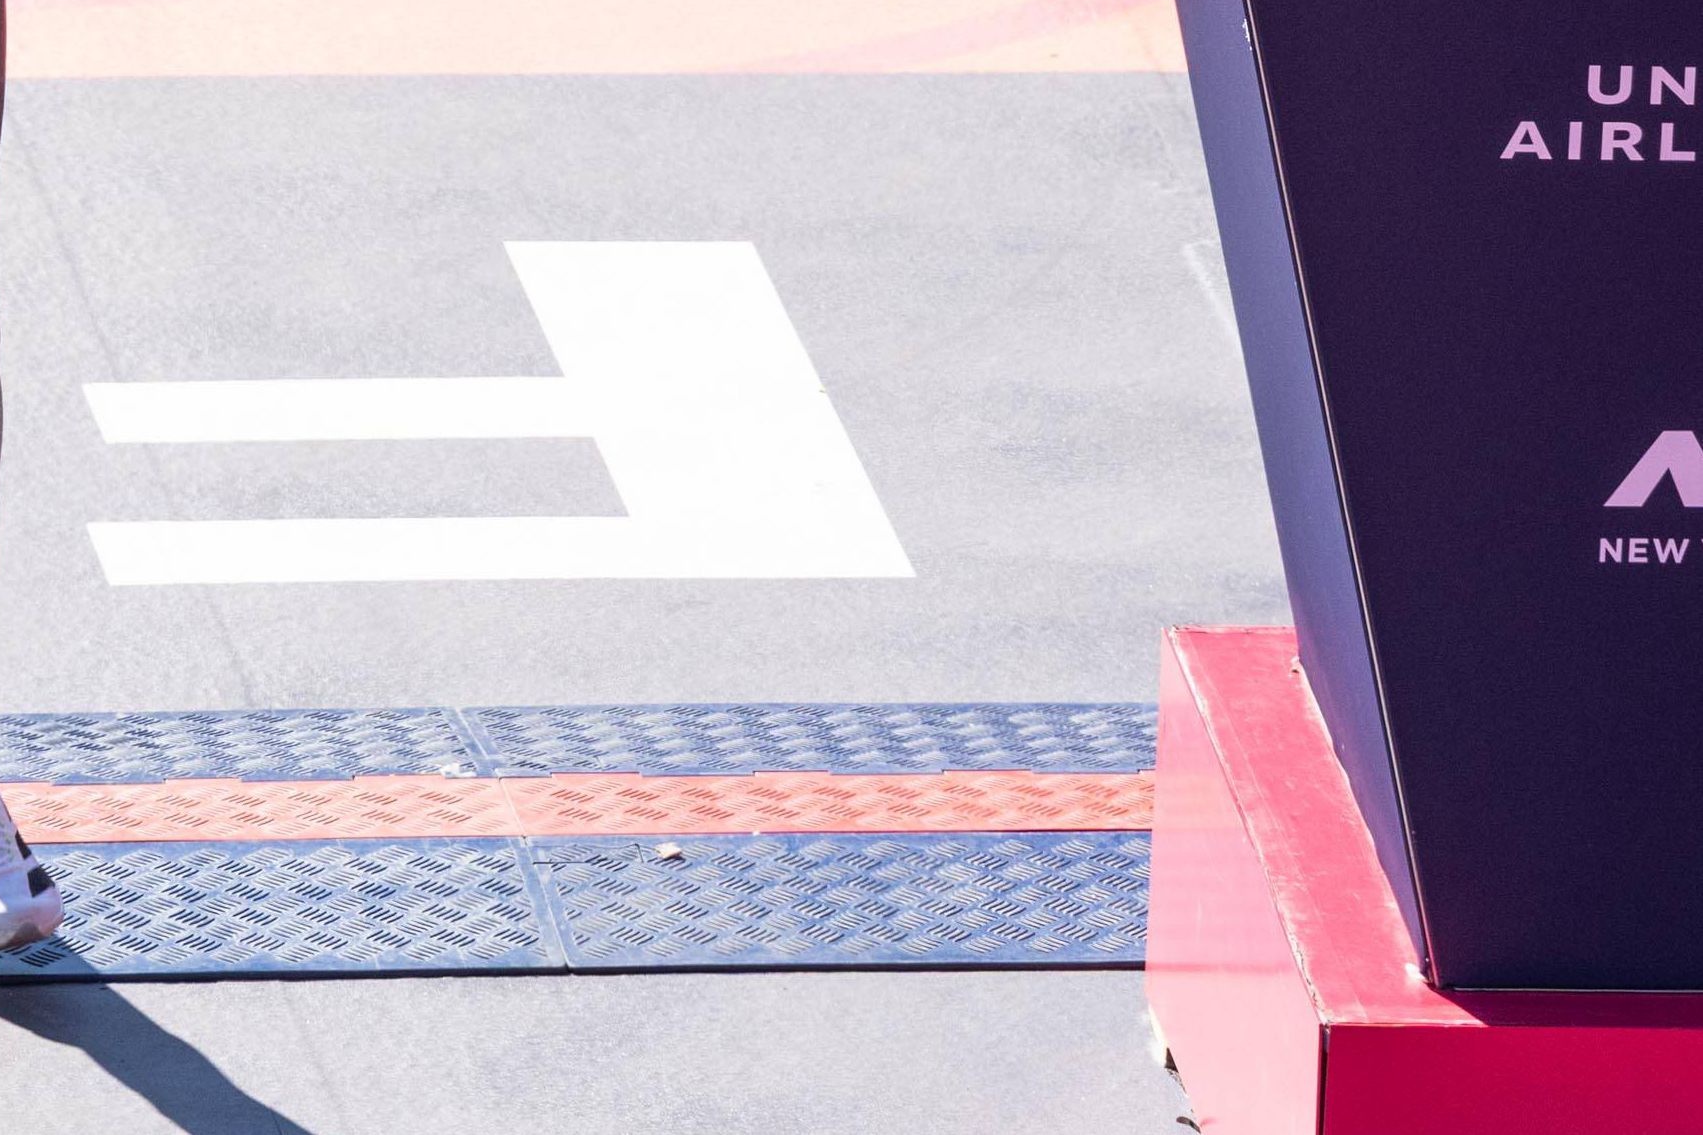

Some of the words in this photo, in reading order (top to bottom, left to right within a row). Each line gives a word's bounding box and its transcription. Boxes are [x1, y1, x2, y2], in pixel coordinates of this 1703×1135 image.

[1587, 64, 1697, 106] UN
[1498, 120, 1697, 162] AIRL
[1599, 537, 1690, 564] NEW
